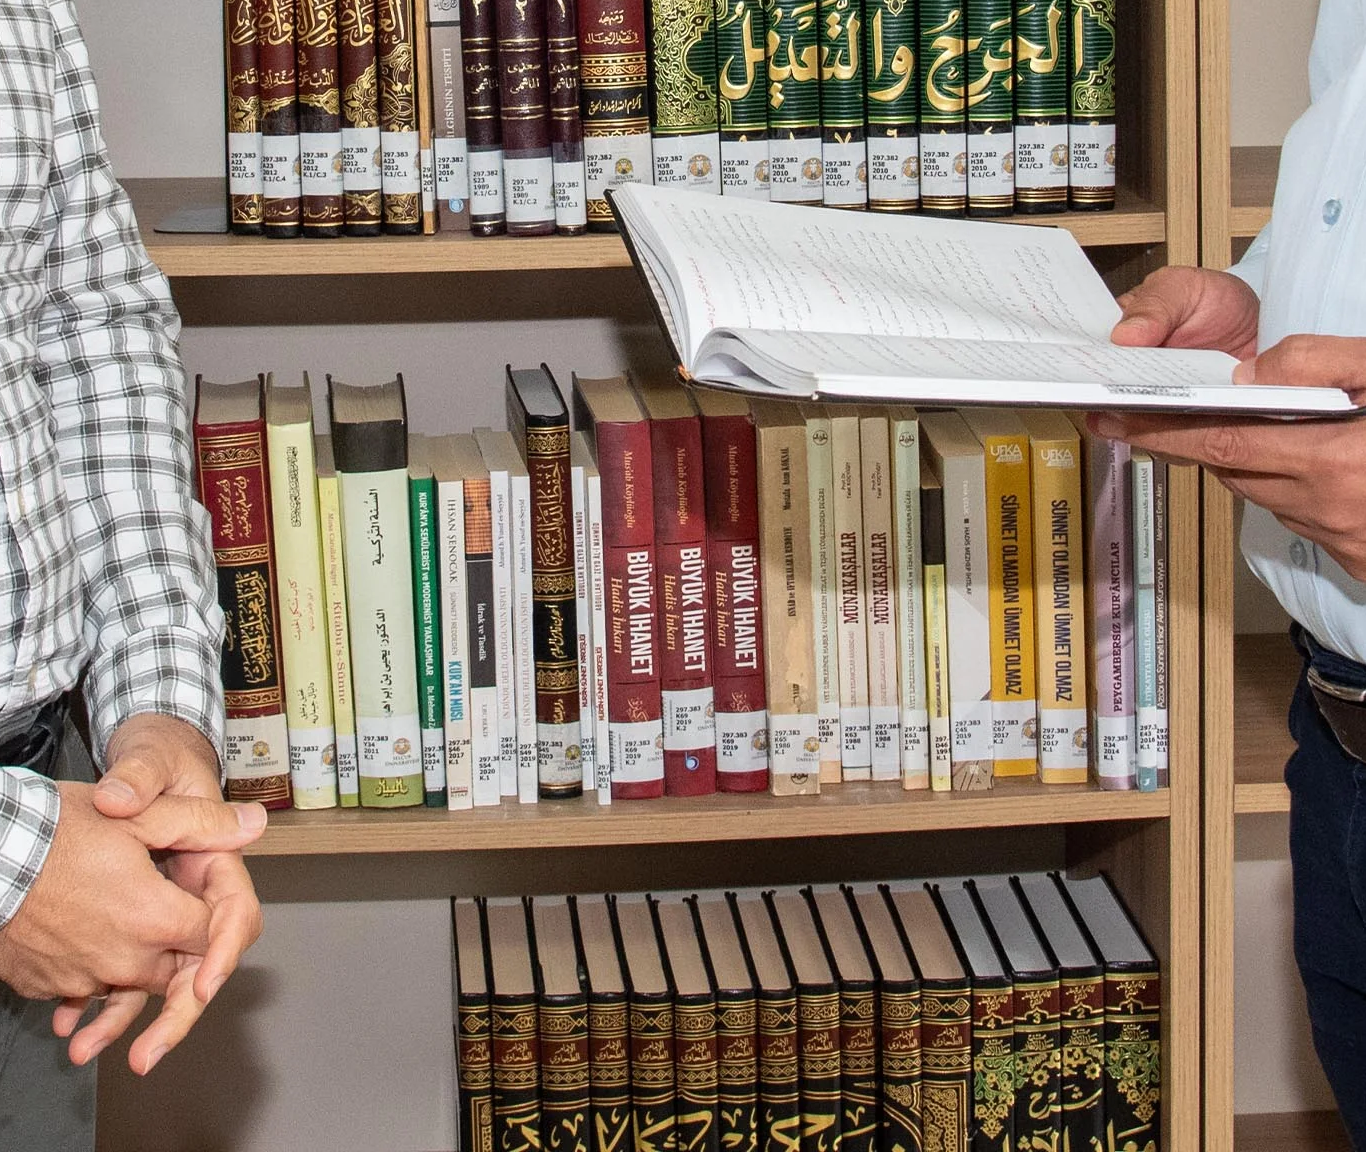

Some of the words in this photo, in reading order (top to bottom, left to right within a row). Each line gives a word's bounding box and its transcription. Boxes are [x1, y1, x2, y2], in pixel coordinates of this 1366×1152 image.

[657, 155, 683, 163] 297.382
[872, 155, 898, 163] 297.382
[1001, 495, 1019, 542] SÜNNET
[1051, 500, 1071, 547] SÜNNET
[420, 528, 430, 570] SEKÜLERİST
[447, 534, 458, 583] ŞENOCAK
[422, 572, 429, 580] ve
[611, 577, 624, 614] Hadis
[627, 551, 654, 610] BÜYÜK
[664, 575, 678, 612] Hadis
[680, 547, 705, 606] BÜYÜK
[715, 571, 728, 608] Hadis
[732, 545, 757, 605] BÜYÜK
[841, 532, 861, 625] MÜNAKAŞALAR
[871, 532, 891, 625] MÜNAKAŞALAR
[1003, 546, 1019, 603] OLMADAN
[1052, 550, 1070, 609] OLMADAN
[422, 582, 432, 624] MODERNİST
[477, 603, 486, 624] İdrak
[424, 625, 434, 676] YAKLAŞIMLAR
[477, 625, 485, 635] ve
[478, 635, 487, 661] Tasdik
[628, 613, 654, 676] İHANET
[682, 609, 706, 671] İHANET
[734, 606, 758, 669] İHANET
[1004, 606, 1022, 655] ÜMMET
[1054, 613, 1073, 657] ÜMMET
[1005, 656, 1022, 695] OLMAZ
[1055, 661, 1072, 702] OLMAZ
[1111, 623, 1123, 712] PEYGAMBERSİZ
[427, 695, 436, 722] Mehmed
